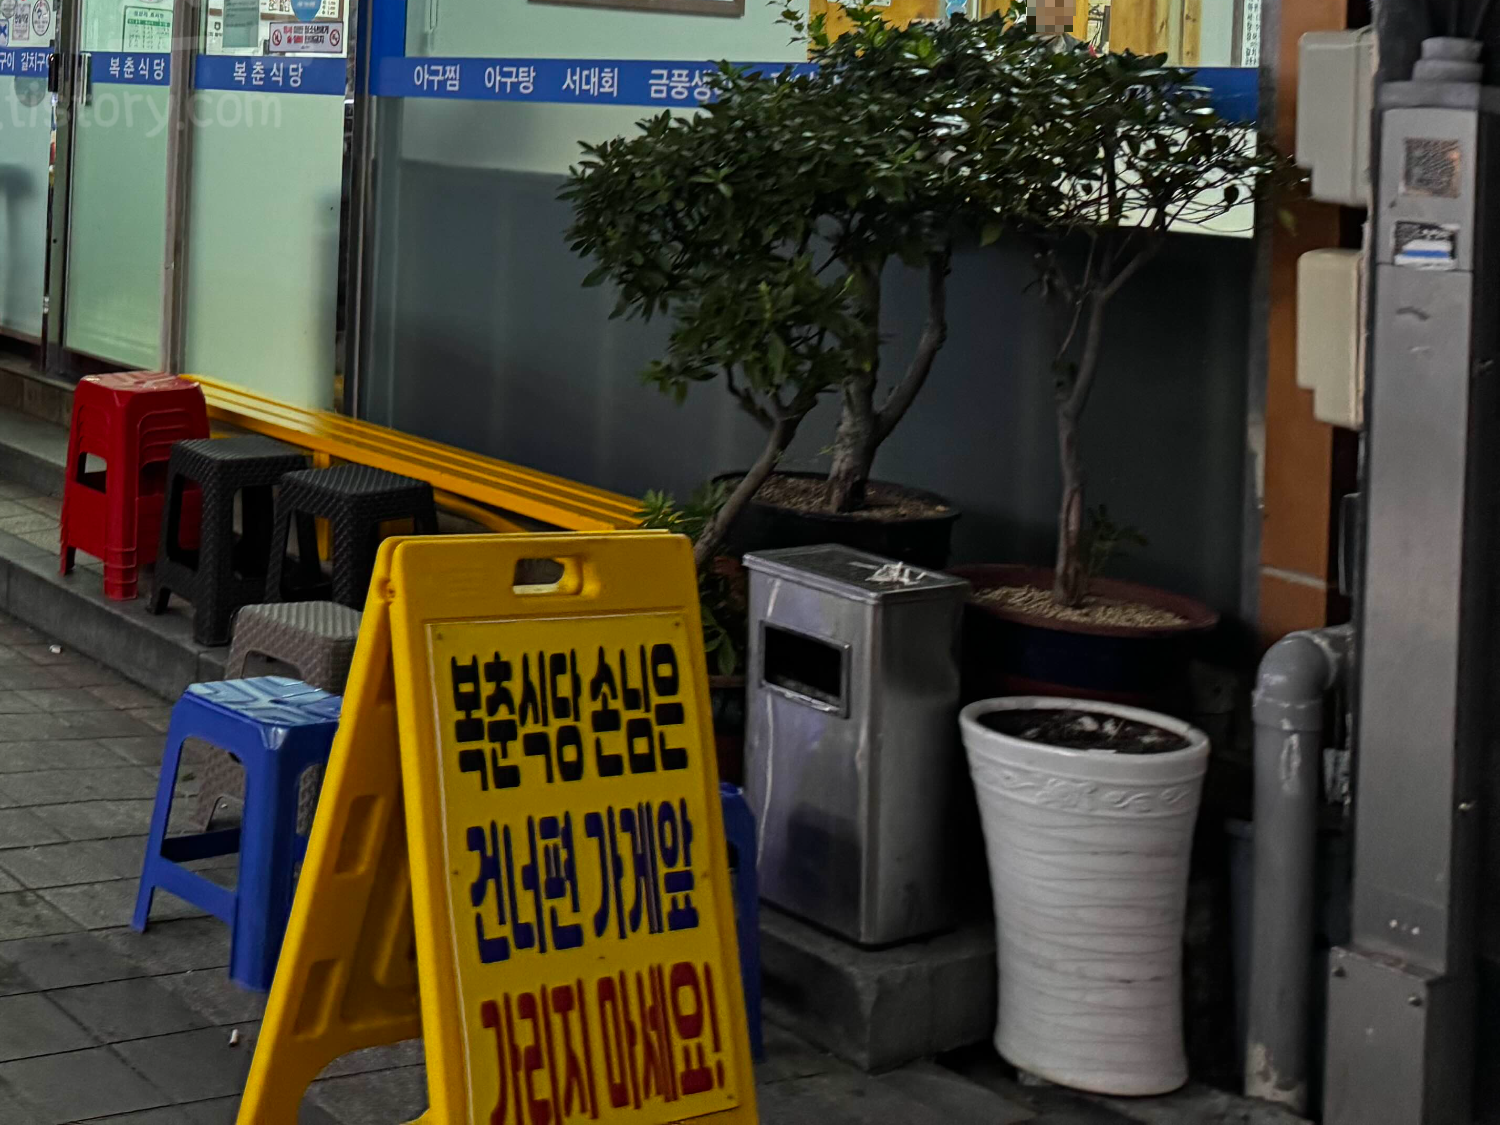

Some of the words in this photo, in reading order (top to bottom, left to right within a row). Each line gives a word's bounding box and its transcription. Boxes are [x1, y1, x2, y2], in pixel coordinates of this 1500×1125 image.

[109, 56, 166, 81] 복춘식당
[233, 61, 304, 88] 복춘식당
[412, 64, 461, 92] 아구찜
[483, 65, 536, 95] 아구탕
[561, 67, 619, 98] 서대회
[648, 68, 732, 101] 금풍생
[450, 647, 584, 791] 복춘식당
[590, 643, 689, 778] 손님은
[466, 810, 585, 964] 건너편
[584, 797, 700, 940] 가게앞
[480, 978, 600, 1125] 가리지
[596, 961, 726, 1111] 마세요!
